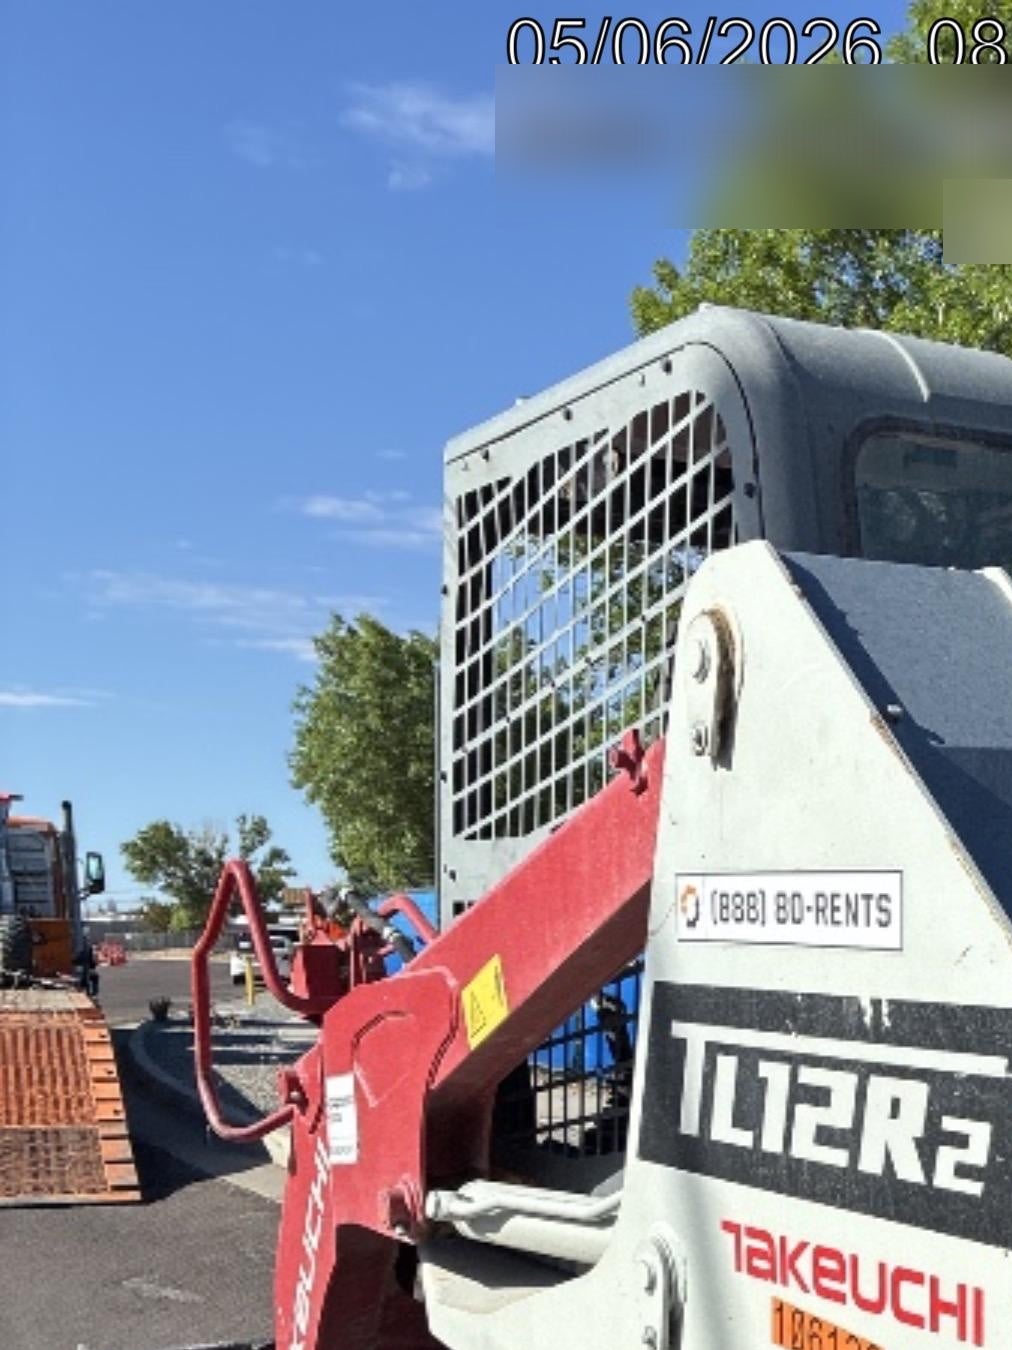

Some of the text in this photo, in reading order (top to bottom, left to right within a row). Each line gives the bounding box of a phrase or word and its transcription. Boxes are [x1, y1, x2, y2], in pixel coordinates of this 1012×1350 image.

[710, 890, 766, 927] (888)
[671, 1021, 1009, 1198] TL12R2
[720, 1220, 985, 1347] TAKEUCHI
